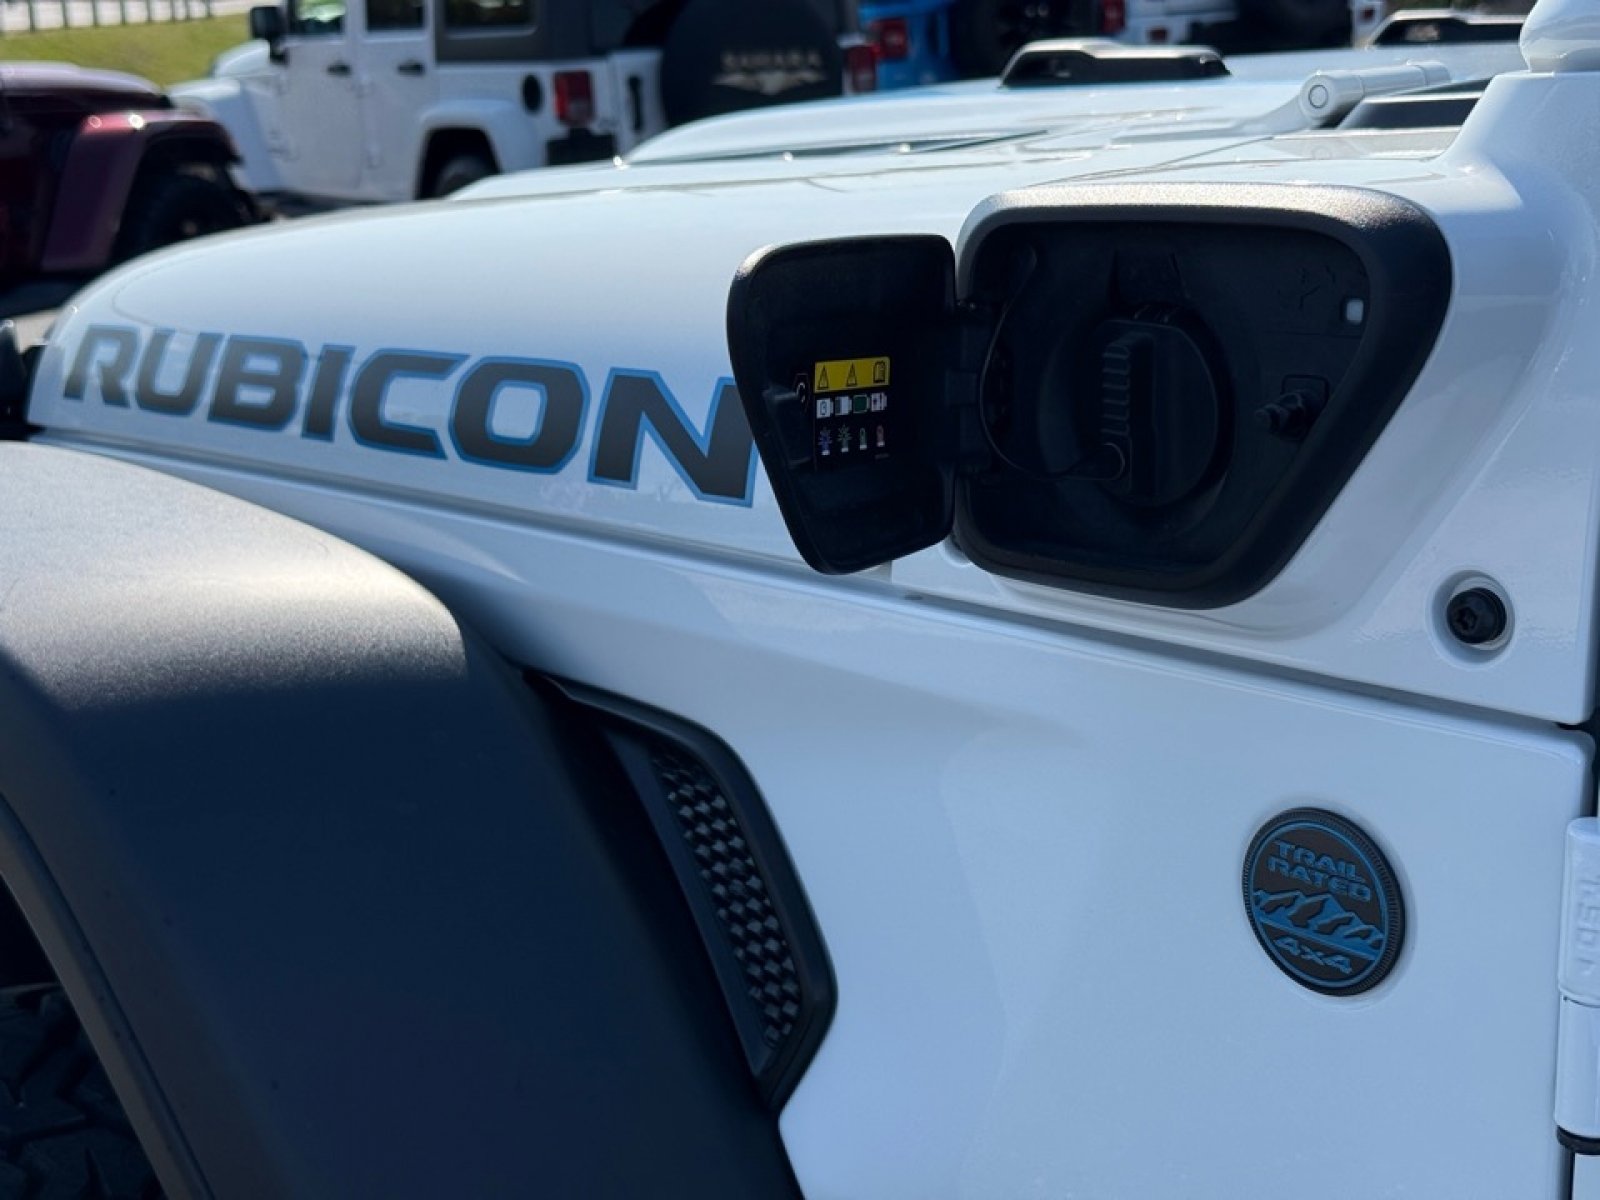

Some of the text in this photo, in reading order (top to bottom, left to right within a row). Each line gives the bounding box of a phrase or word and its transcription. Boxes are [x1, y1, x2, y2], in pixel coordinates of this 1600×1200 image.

[63, 324, 755, 507] RUBICON
[1266, 856, 1371, 902] RATED
[1272, 839, 1367, 883] TRAIL
